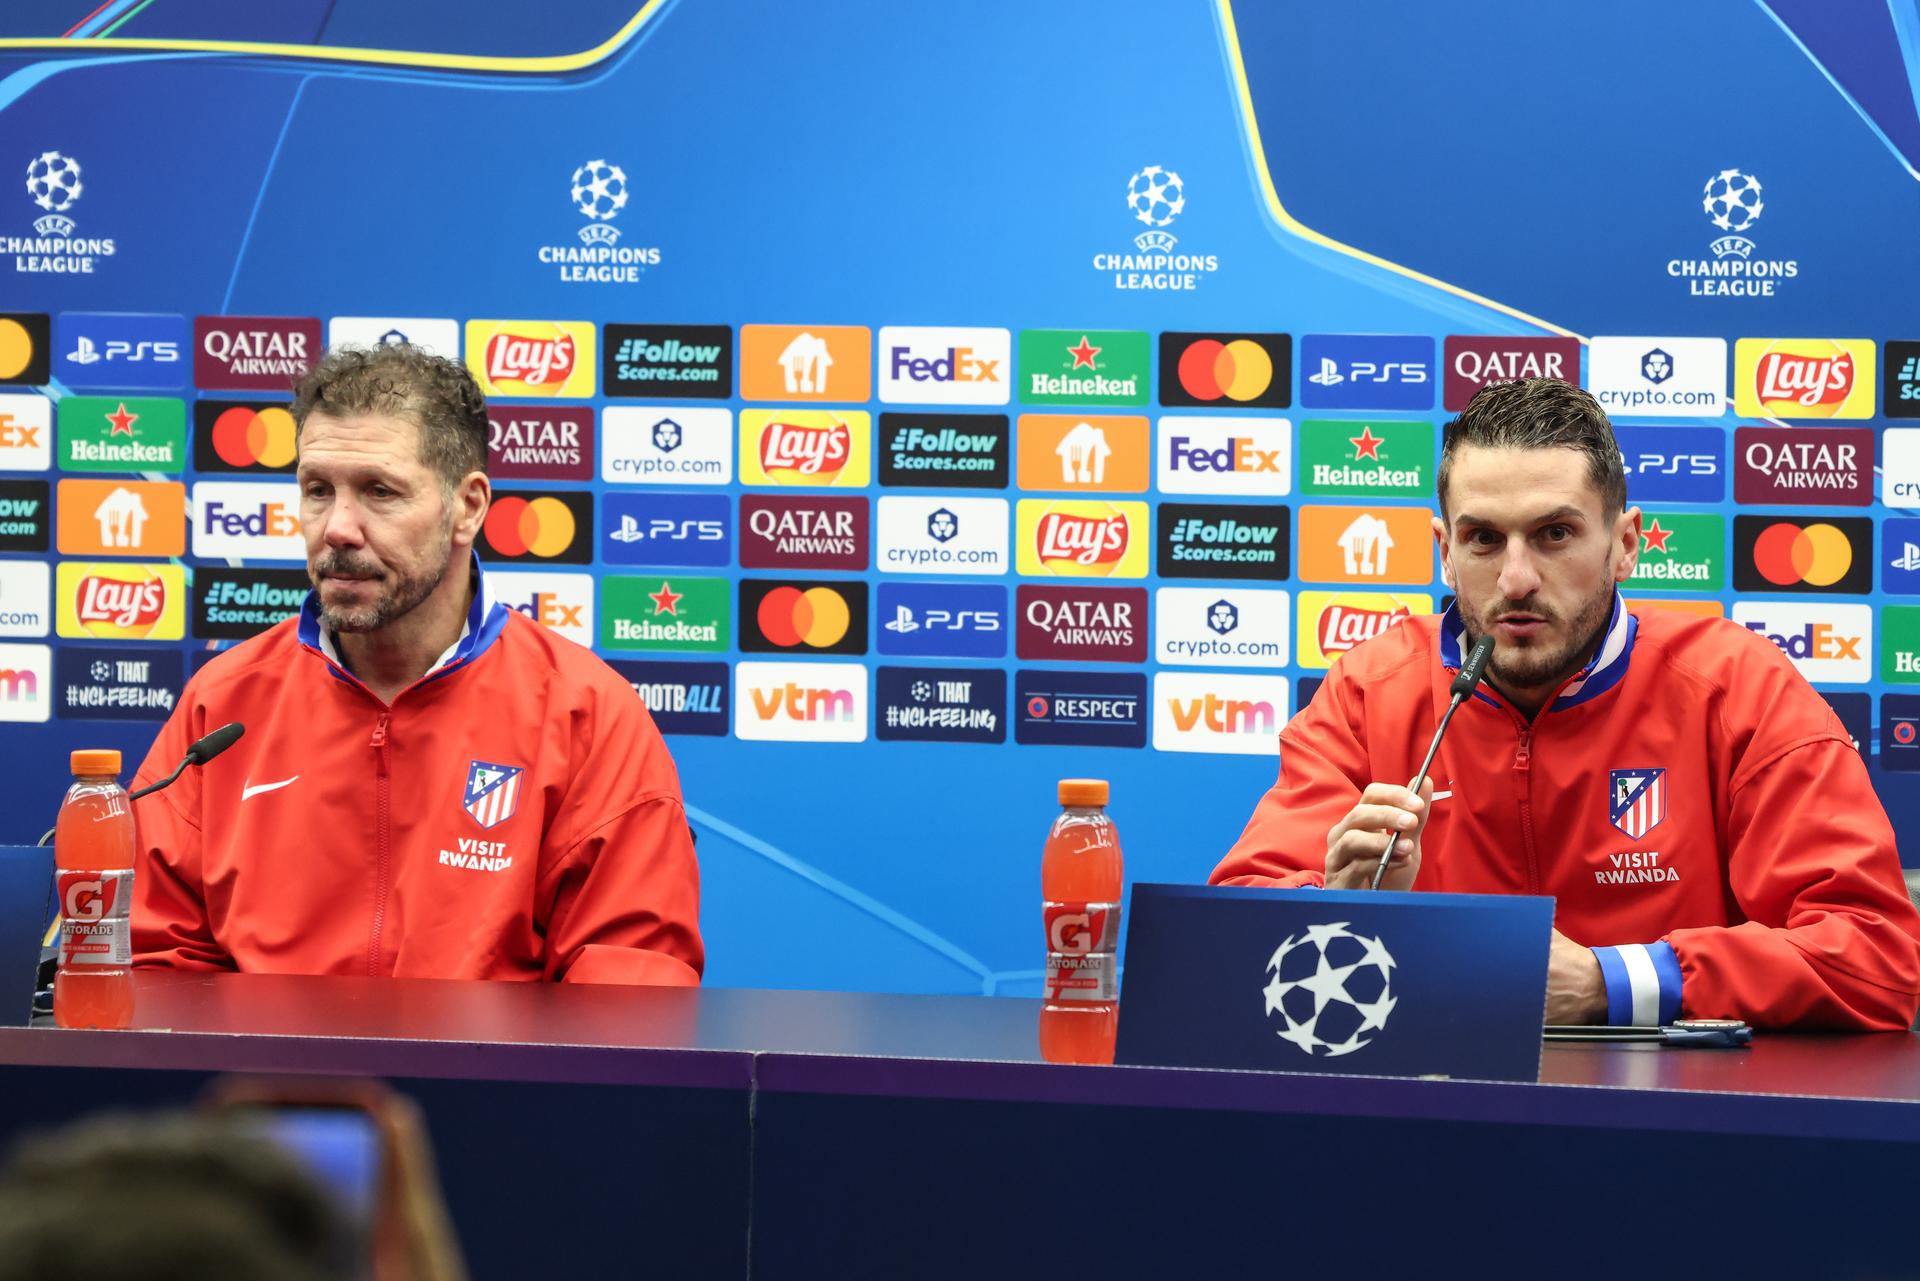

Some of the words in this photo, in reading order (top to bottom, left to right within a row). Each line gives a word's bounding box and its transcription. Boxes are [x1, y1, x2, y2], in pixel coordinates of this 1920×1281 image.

[580, 226, 619, 246] UEFA
[1135, 233, 1175, 251] UEFA
[538, 246, 661, 265] CHAMPIONS
[1711, 239, 1752, 257] UEFA
[16, 256, 94, 273] LEAGUE
[1093, 254, 1218, 271] CHAMPIONS
[1667, 260, 1798, 277] CHAMPIONS
[560, 266, 639, 282] LEAGUE
[1116, 273, 1196, 290] LEAGUE
[1691, 280, 1775, 296] LEAGUE
[106, 341, 178, 361] PS5
[204, 330, 307, 362] QATAR
[630, 339, 721, 363] Follow
[230, 359, 308, 375] AIRWAYS
[490, 335, 571, 385] Lay's
[891, 346, 1000, 382] FedEx
[1455, 350, 1564, 383] QATAR
[617, 364, 719, 381] Scores.com
[1351, 362, 1427, 383] PS5
[1762, 354, 1849, 406] Lay's
[1031, 374, 1136, 396] Heineken
[1600, 388, 1716, 406] crypto.com
[71, 440, 172, 462] Heineken
[764, 424, 846, 475] Lay's
[906, 429, 997, 452] Follow
[502, 448, 580, 465] AIRWAYS
[893, 454, 995, 471] Scores.com
[1170, 437, 1280, 473] FedEx
[1639, 454, 1717, 475] PS5
[1746, 442, 1857, 475] QATAR
[613, 458, 721, 474] crypto.com
[1313, 465, 1420, 487] Heineken
[1773, 471, 1858, 489] AIRWAYS
[650, 520, 723, 540] PS5
[750, 509, 854, 541] QATAR
[1186, 519, 1278, 544] Follow
[776, 537, 855, 554] AIRWAYS
[1042, 514, 1123, 566] Lay's
[888, 547, 998, 564] crypto.com
[1172, 544, 1275, 562] Scores.com
[1630, 558, 1709, 580] neken
[82, 577, 160, 628] Lay's
[220, 582, 308, 606] Follow
[207, 607, 300, 623] Scores.co
[502, 592, 583, 628] dEx
[925, 610, 999, 631] PS5
[1026, 600, 1132, 632] QATAR
[614, 619, 717, 641] Heineken
[1053, 628, 1133, 645] AIRWAYS
[1167, 638, 1279, 656] crypto.com
[116, 661, 149, 683] THAT
[633, 683, 721, 713] OOTBALL
[749, 683, 854, 722] vtm
[938, 682, 971, 703] THAT
[1055, 700, 1136, 719] RESPECT
[1168, 693, 1275, 734] vtm
[458, 838, 506, 857] VISIT
[439, 850, 512, 872] RWANDA
[1609, 852, 1659, 868] VISIT
[1594, 867, 1680, 884] RWANDA
[66, 880, 103, 923] G
[1051, 913, 1092, 957] G
